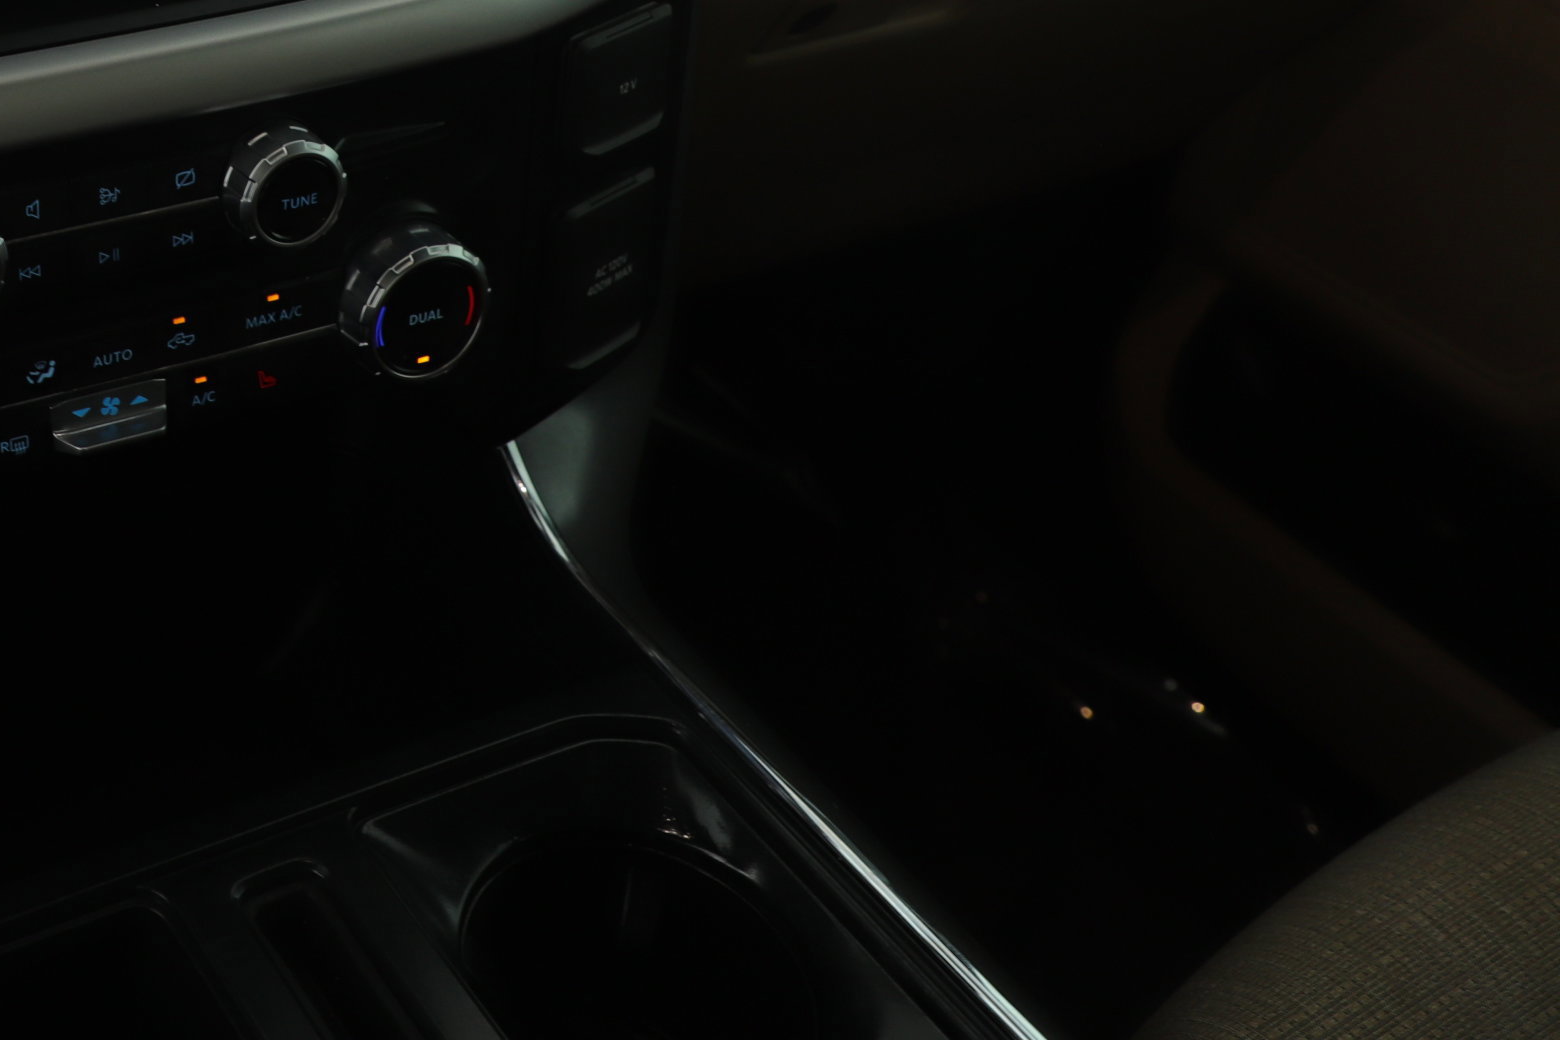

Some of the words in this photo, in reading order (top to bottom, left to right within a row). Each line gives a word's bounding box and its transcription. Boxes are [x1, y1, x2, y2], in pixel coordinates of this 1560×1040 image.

[281, 192, 320, 211] TUNE
[245, 310, 276, 329] MAX
[276, 303, 304, 322] A/C
[408, 308, 444, 327] DUAL
[92, 348, 134, 369] AUTO
[192, 390, 216, 408] A/C
